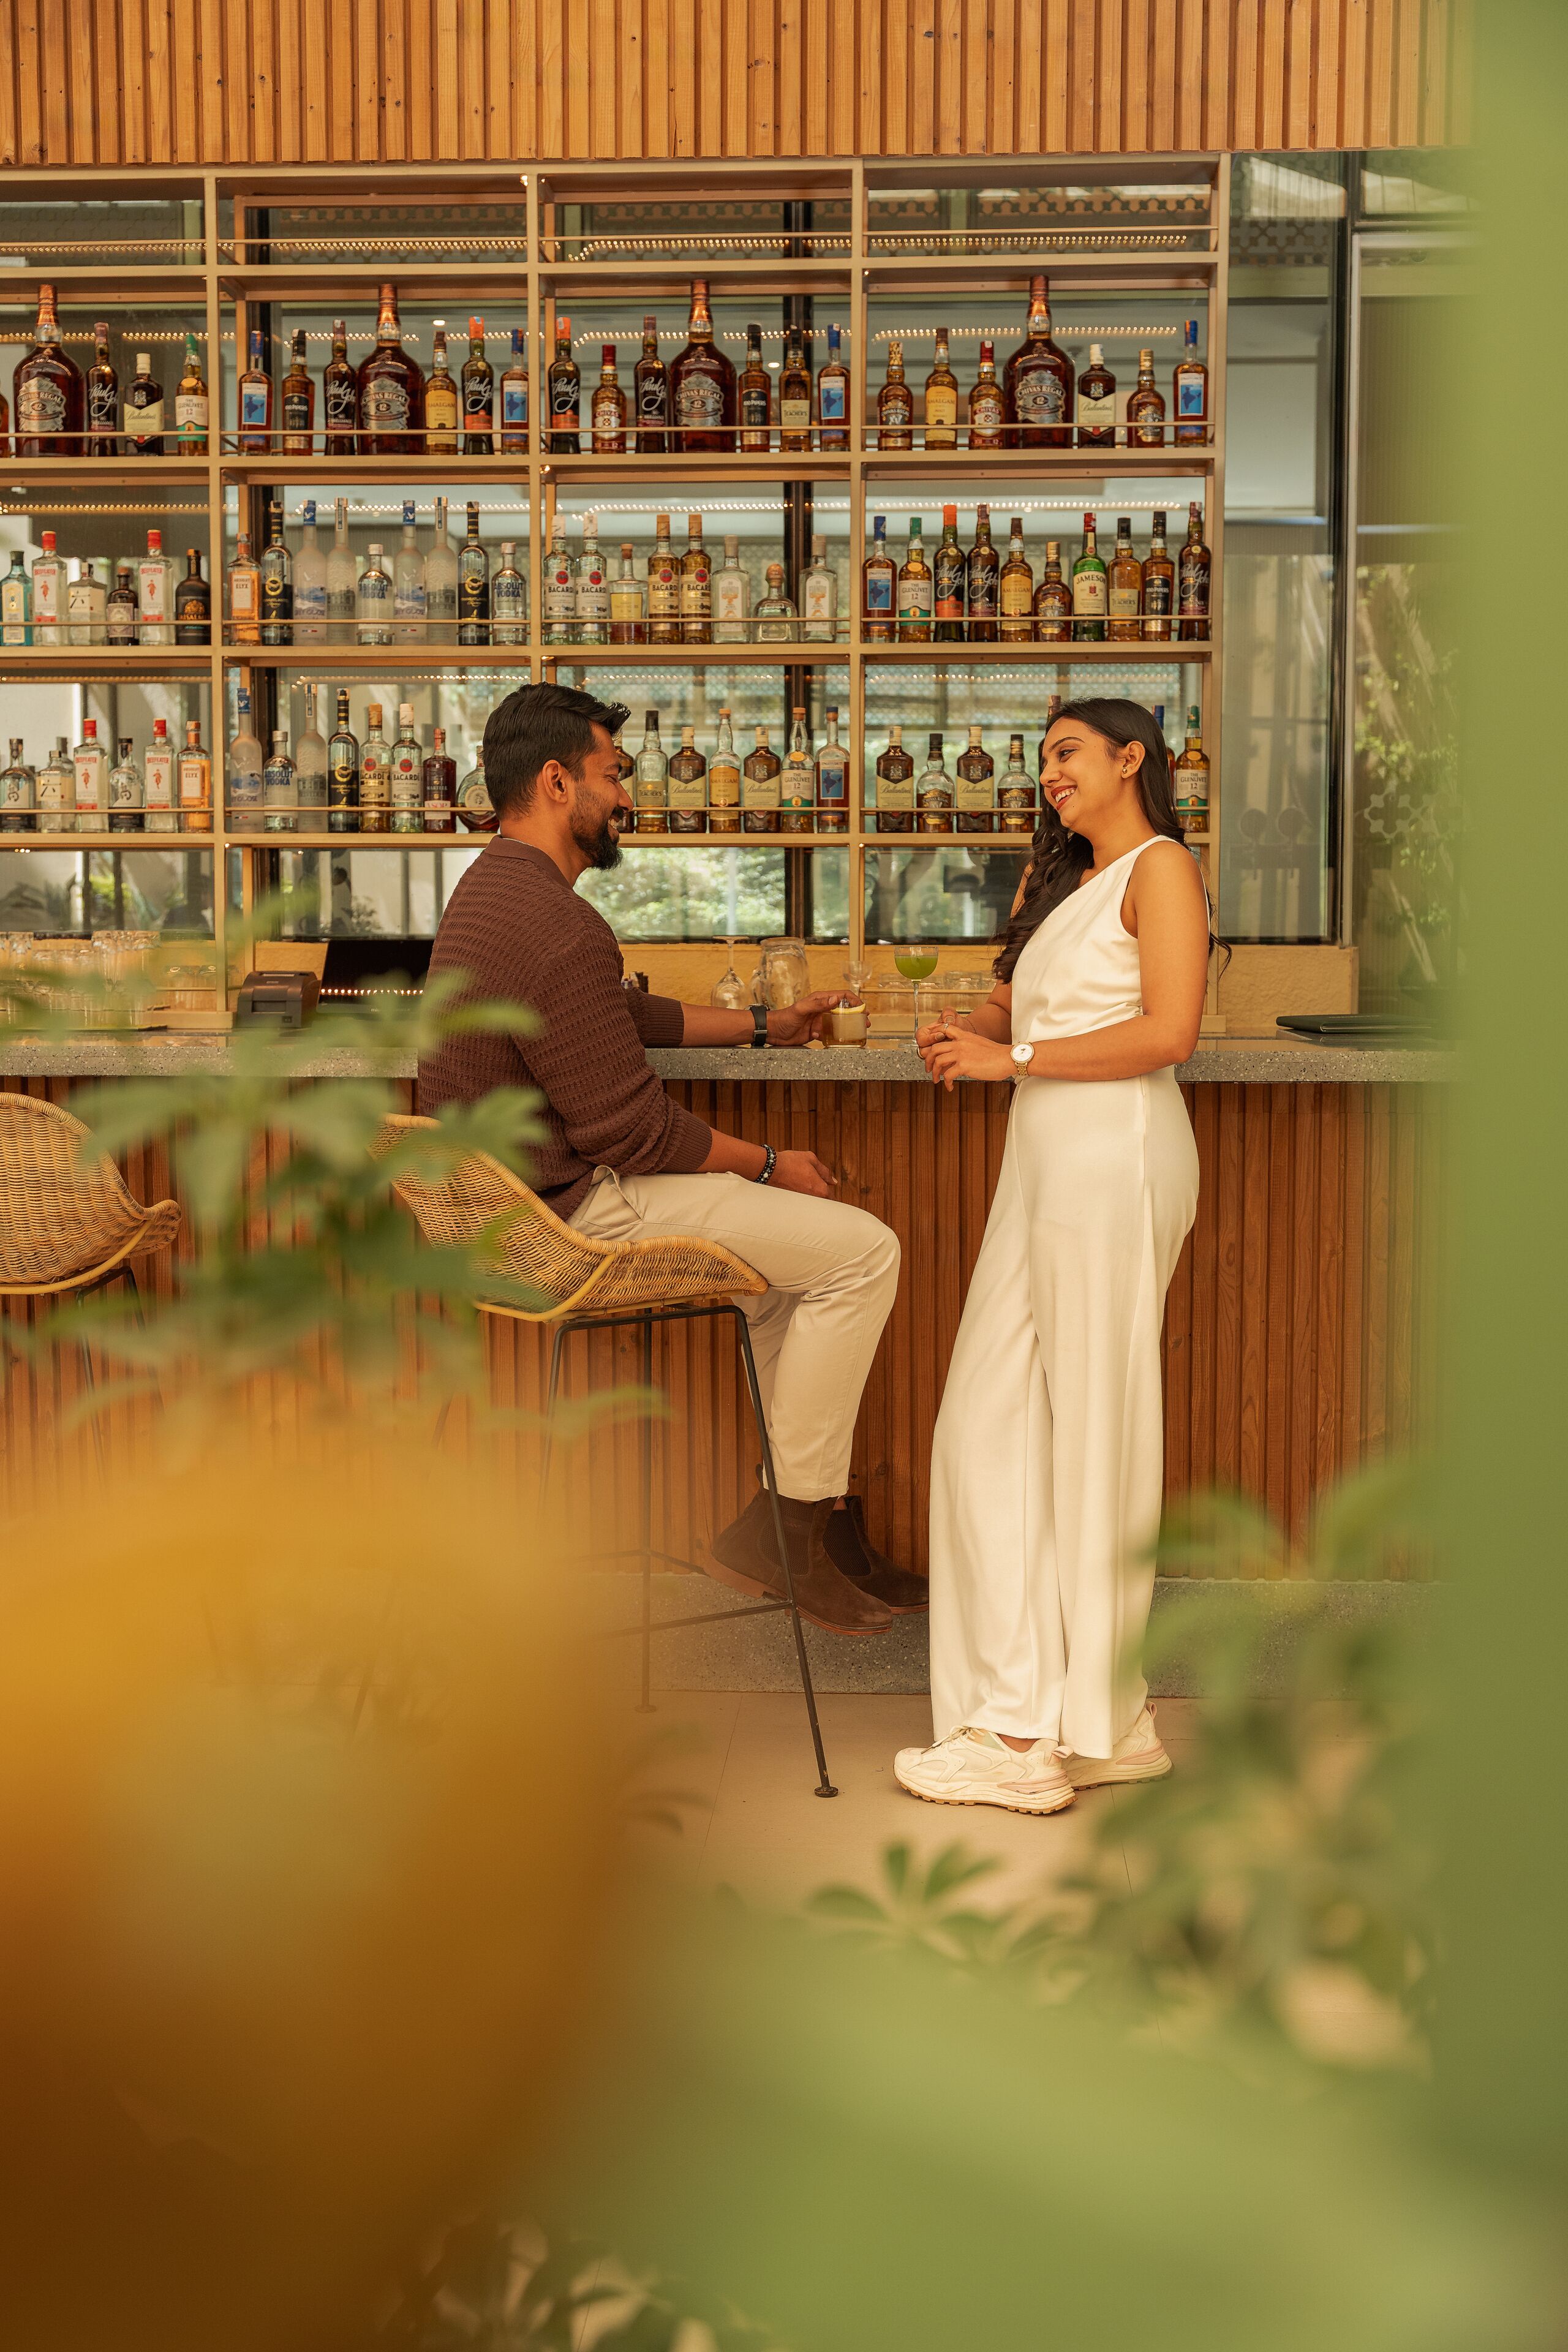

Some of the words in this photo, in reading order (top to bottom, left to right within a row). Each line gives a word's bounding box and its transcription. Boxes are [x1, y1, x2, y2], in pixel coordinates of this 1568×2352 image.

[89, 383, 112, 400] Paul
[325, 380, 349, 397] Paul
[464, 376, 489, 394] Paul
[552, 377, 577, 394] Paul
[640, 376, 663, 392] Paul
[1018, 386, 1041, 397] CHIVAS
[1041, 385, 1063, 397] REGAL
[39, 392, 62, 404] REGAL
[699, 389, 722, 400] REGAL
[936, 564, 960, 580] Paul
[1077, 575, 1106, 584] JAMESON
